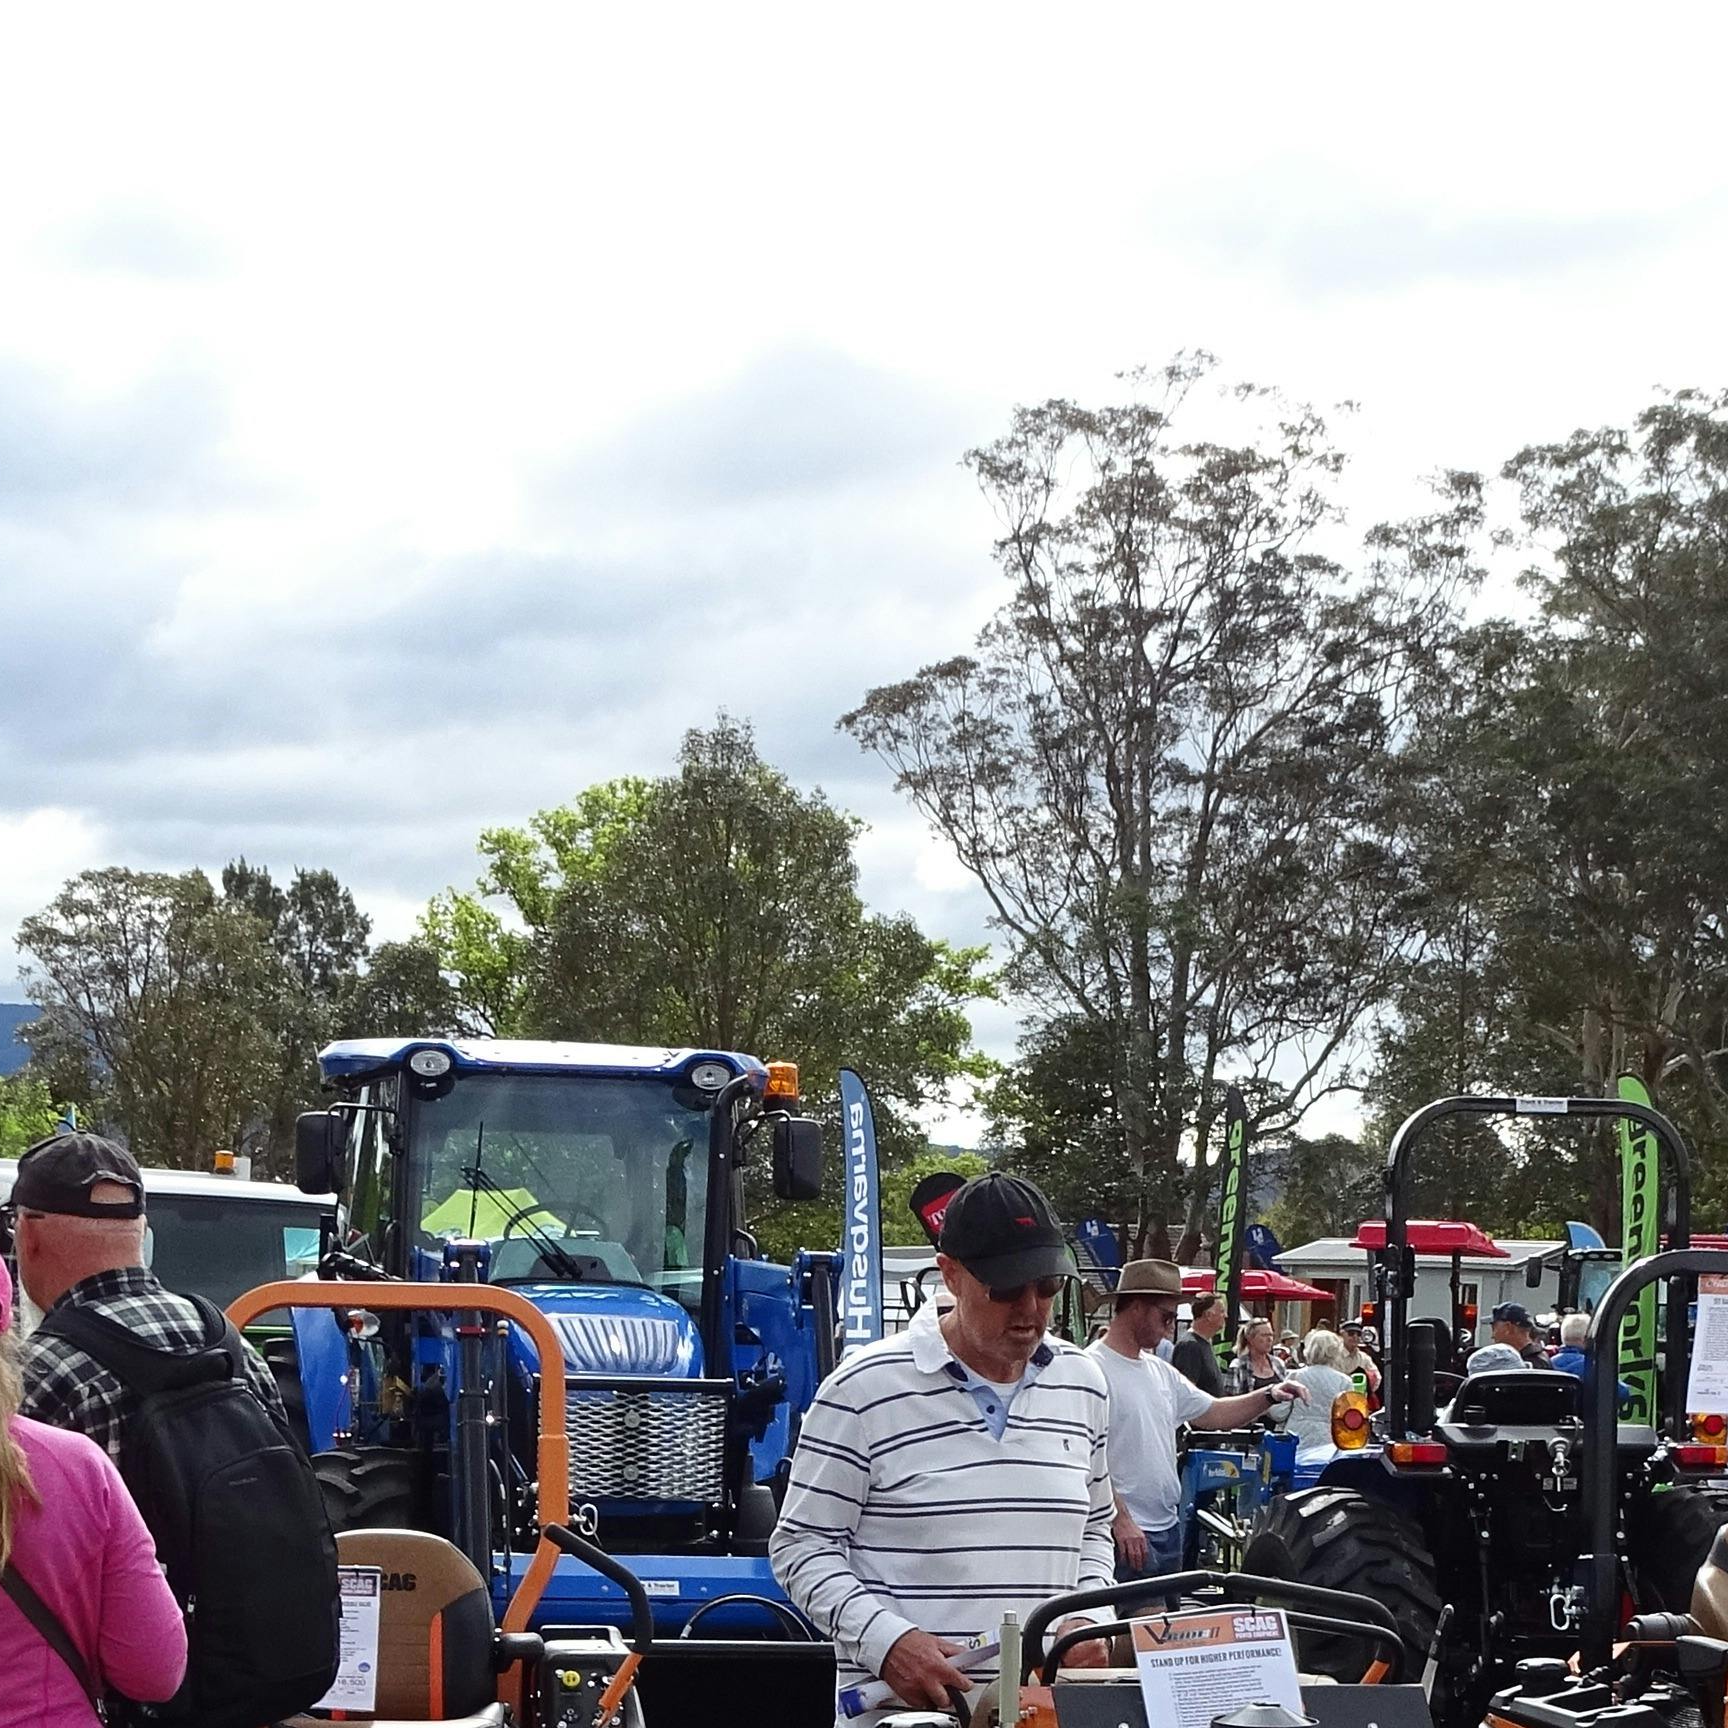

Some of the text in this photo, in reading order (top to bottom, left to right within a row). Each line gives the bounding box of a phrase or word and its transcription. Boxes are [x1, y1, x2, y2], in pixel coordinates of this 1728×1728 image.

[1232, 1614, 1278, 1634] SCAG
[1150, 1657, 1175, 1669] STAND
[1175, 1656, 1185, 1667] UP
[1185, 1655, 1200, 1666] FOR
[1200, 1651, 1228, 1664] HIGHER
